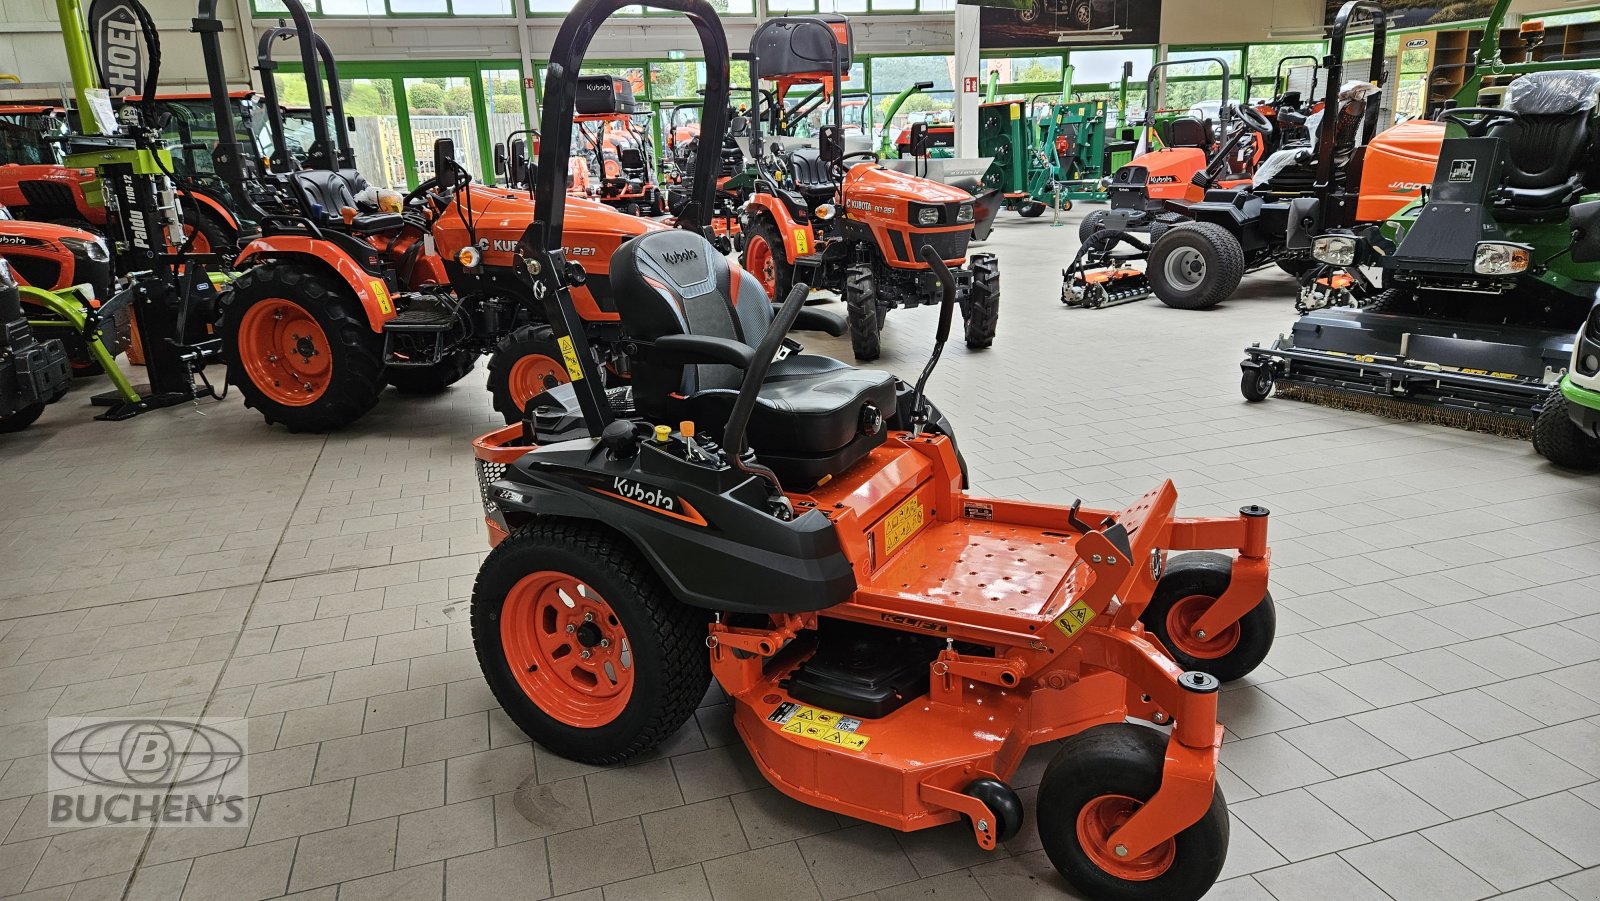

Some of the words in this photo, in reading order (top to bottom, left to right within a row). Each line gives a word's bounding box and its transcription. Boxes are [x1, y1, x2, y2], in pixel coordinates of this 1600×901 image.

[123, 174, 136, 204] 1100-12
[852, 200, 872, 211] KUBOTA
[662, 249, 697, 264] Kubota
[614, 476, 673, 510] Kubota
[884, 614, 941, 631] K-LIFT
[837, 722, 851, 731] 105
